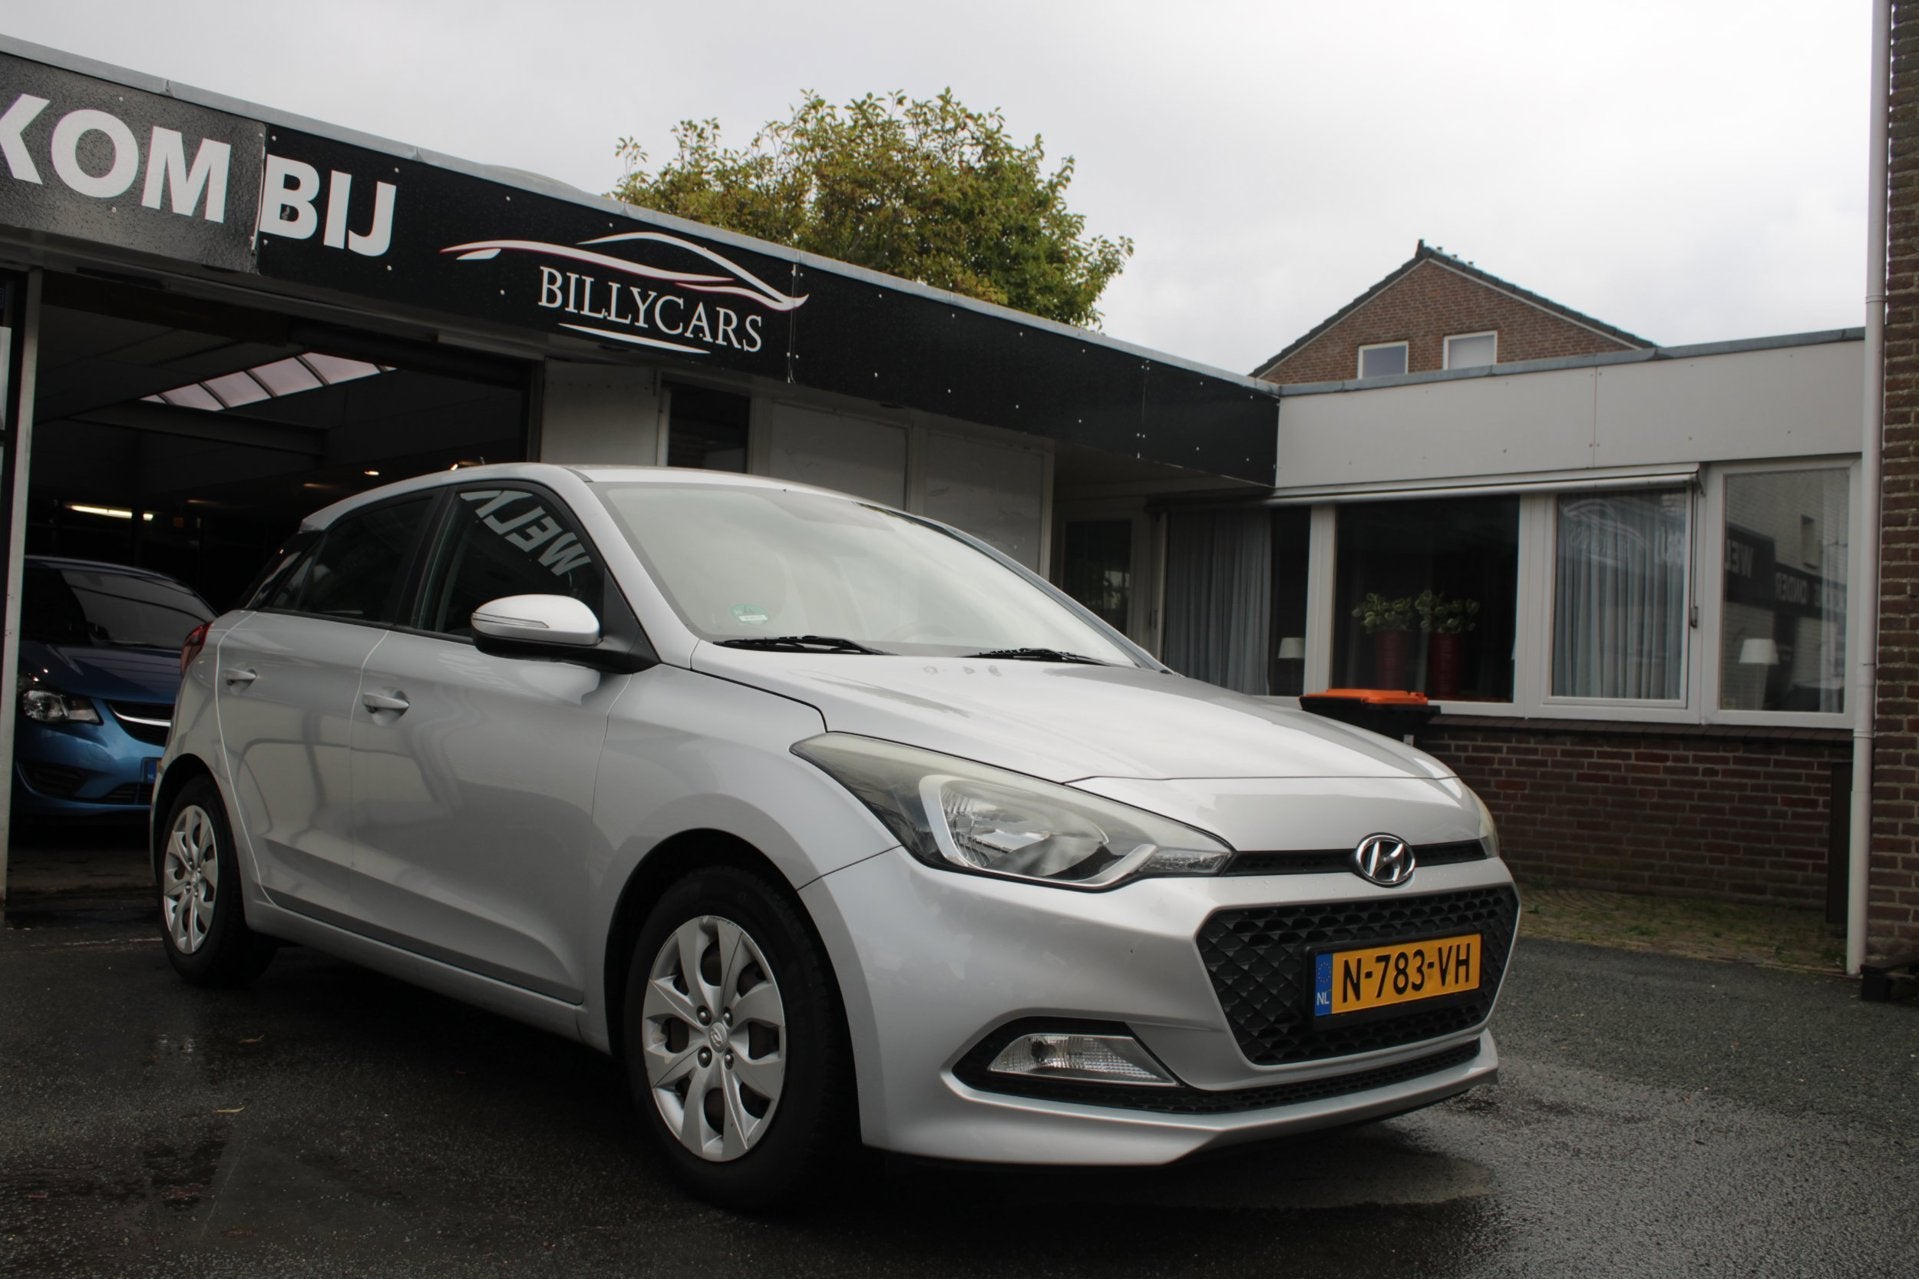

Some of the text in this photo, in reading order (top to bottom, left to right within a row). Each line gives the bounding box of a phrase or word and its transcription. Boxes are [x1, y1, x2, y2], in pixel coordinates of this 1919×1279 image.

[259, 153, 398, 257] BIJ
[538, 266, 763, 354] BILLYCARS
[1316, 991, 1330, 1006] NL
[1342, 942, 1471, 1004] N-783-VH
